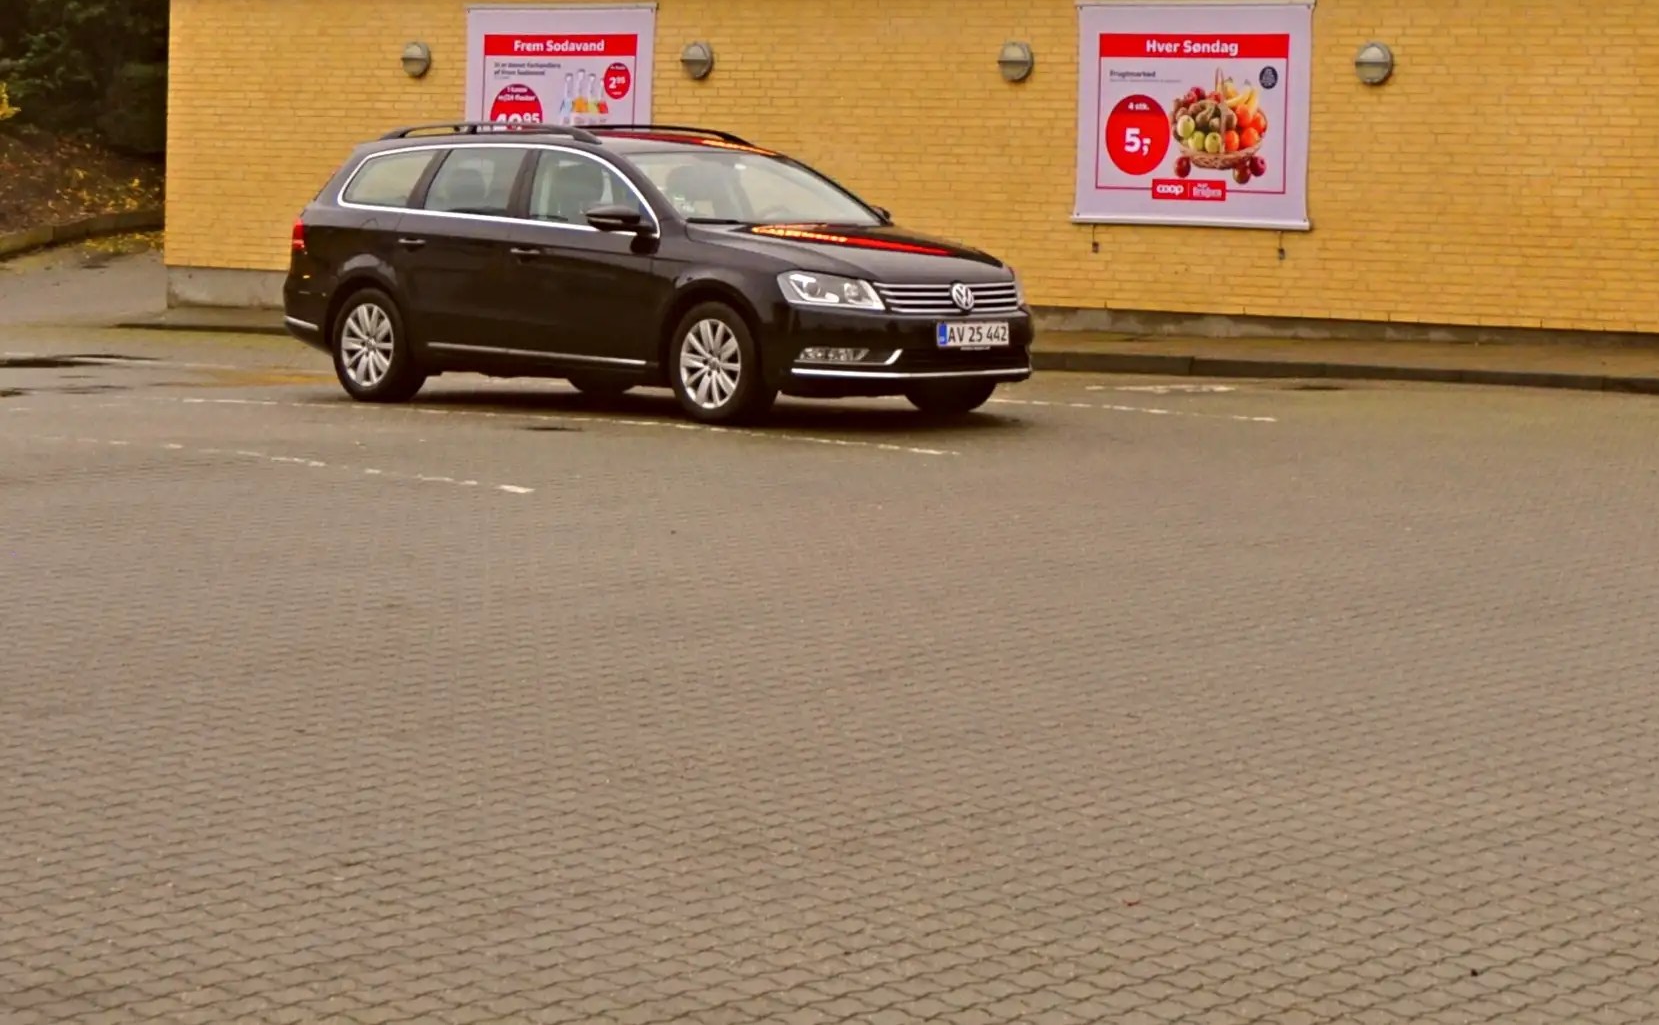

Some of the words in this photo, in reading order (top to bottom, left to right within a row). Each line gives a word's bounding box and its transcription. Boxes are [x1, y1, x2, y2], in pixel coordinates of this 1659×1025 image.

[513, 40, 544, 52] Frem
[546, 40, 605, 52] Sodavand
[1146, 40, 1179, 53] Hver
[1183, 40, 1239, 57] Søndag
[1127, 102, 1134, 111] 4
[1156, 184, 1184, 197] coop
[948, 326, 965, 343] AV
[968, 326, 983, 343] 25
[986, 325, 1007, 342] 442
